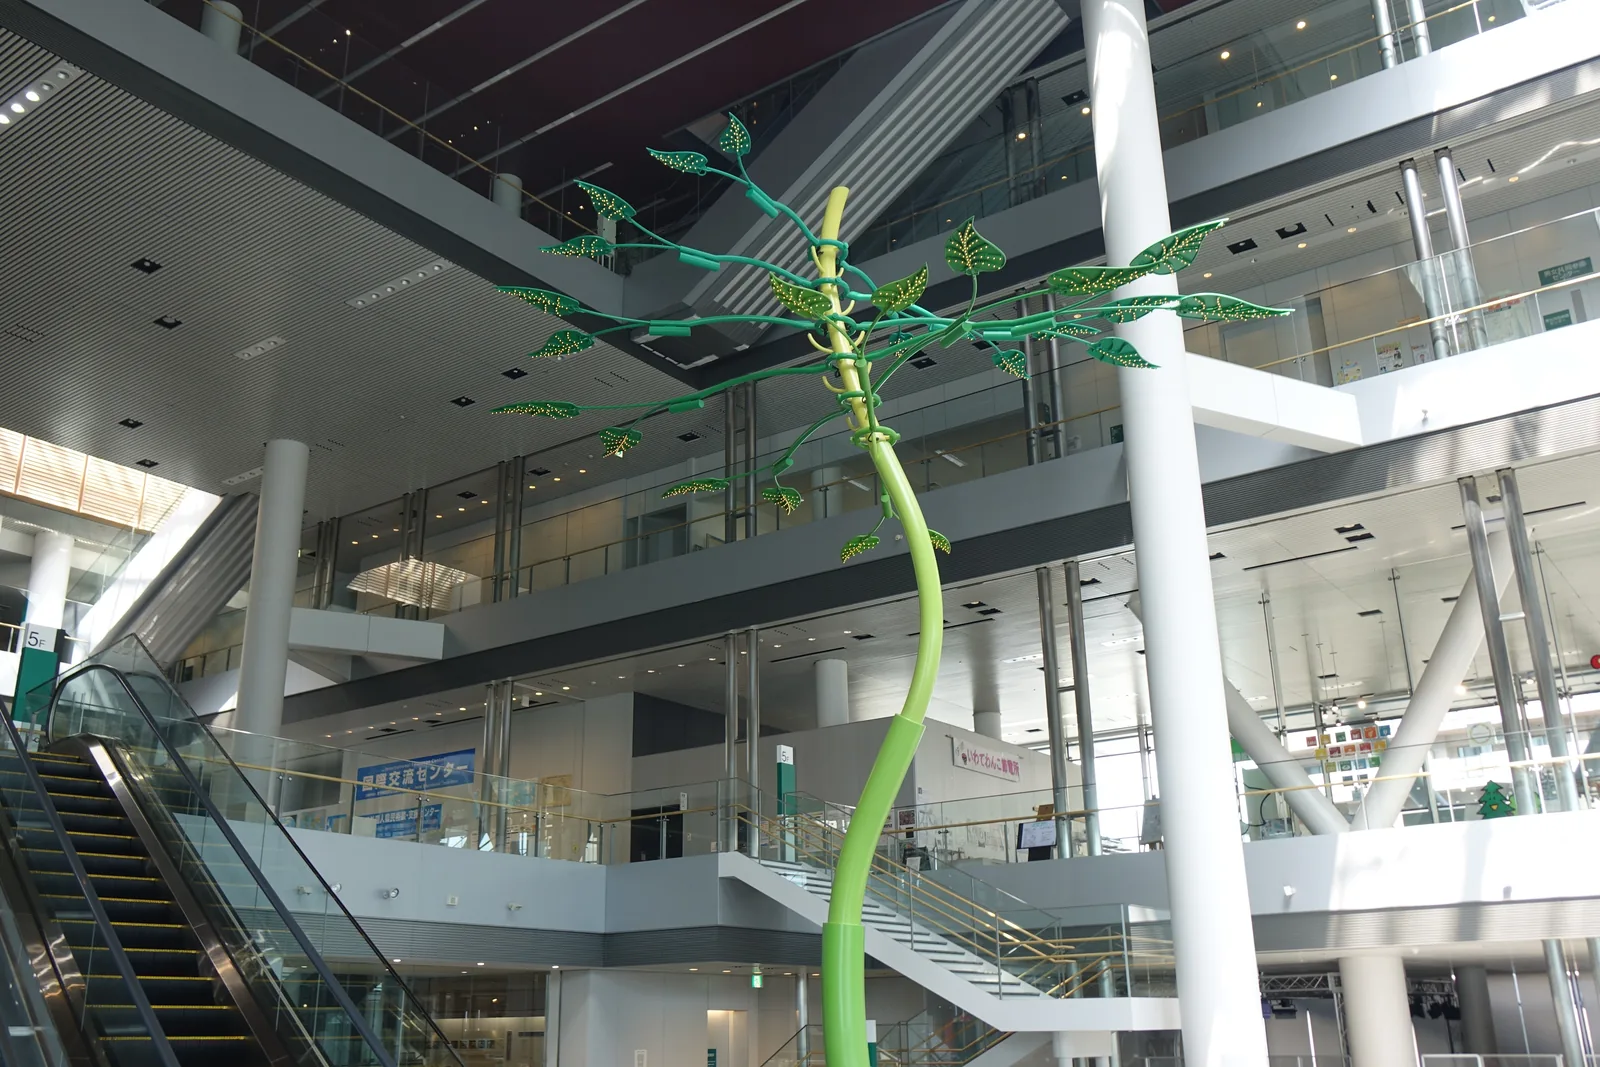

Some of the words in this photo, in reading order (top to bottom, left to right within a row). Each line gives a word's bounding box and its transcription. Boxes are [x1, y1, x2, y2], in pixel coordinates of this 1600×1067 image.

[362, 762, 469, 791] 国際交流センター
